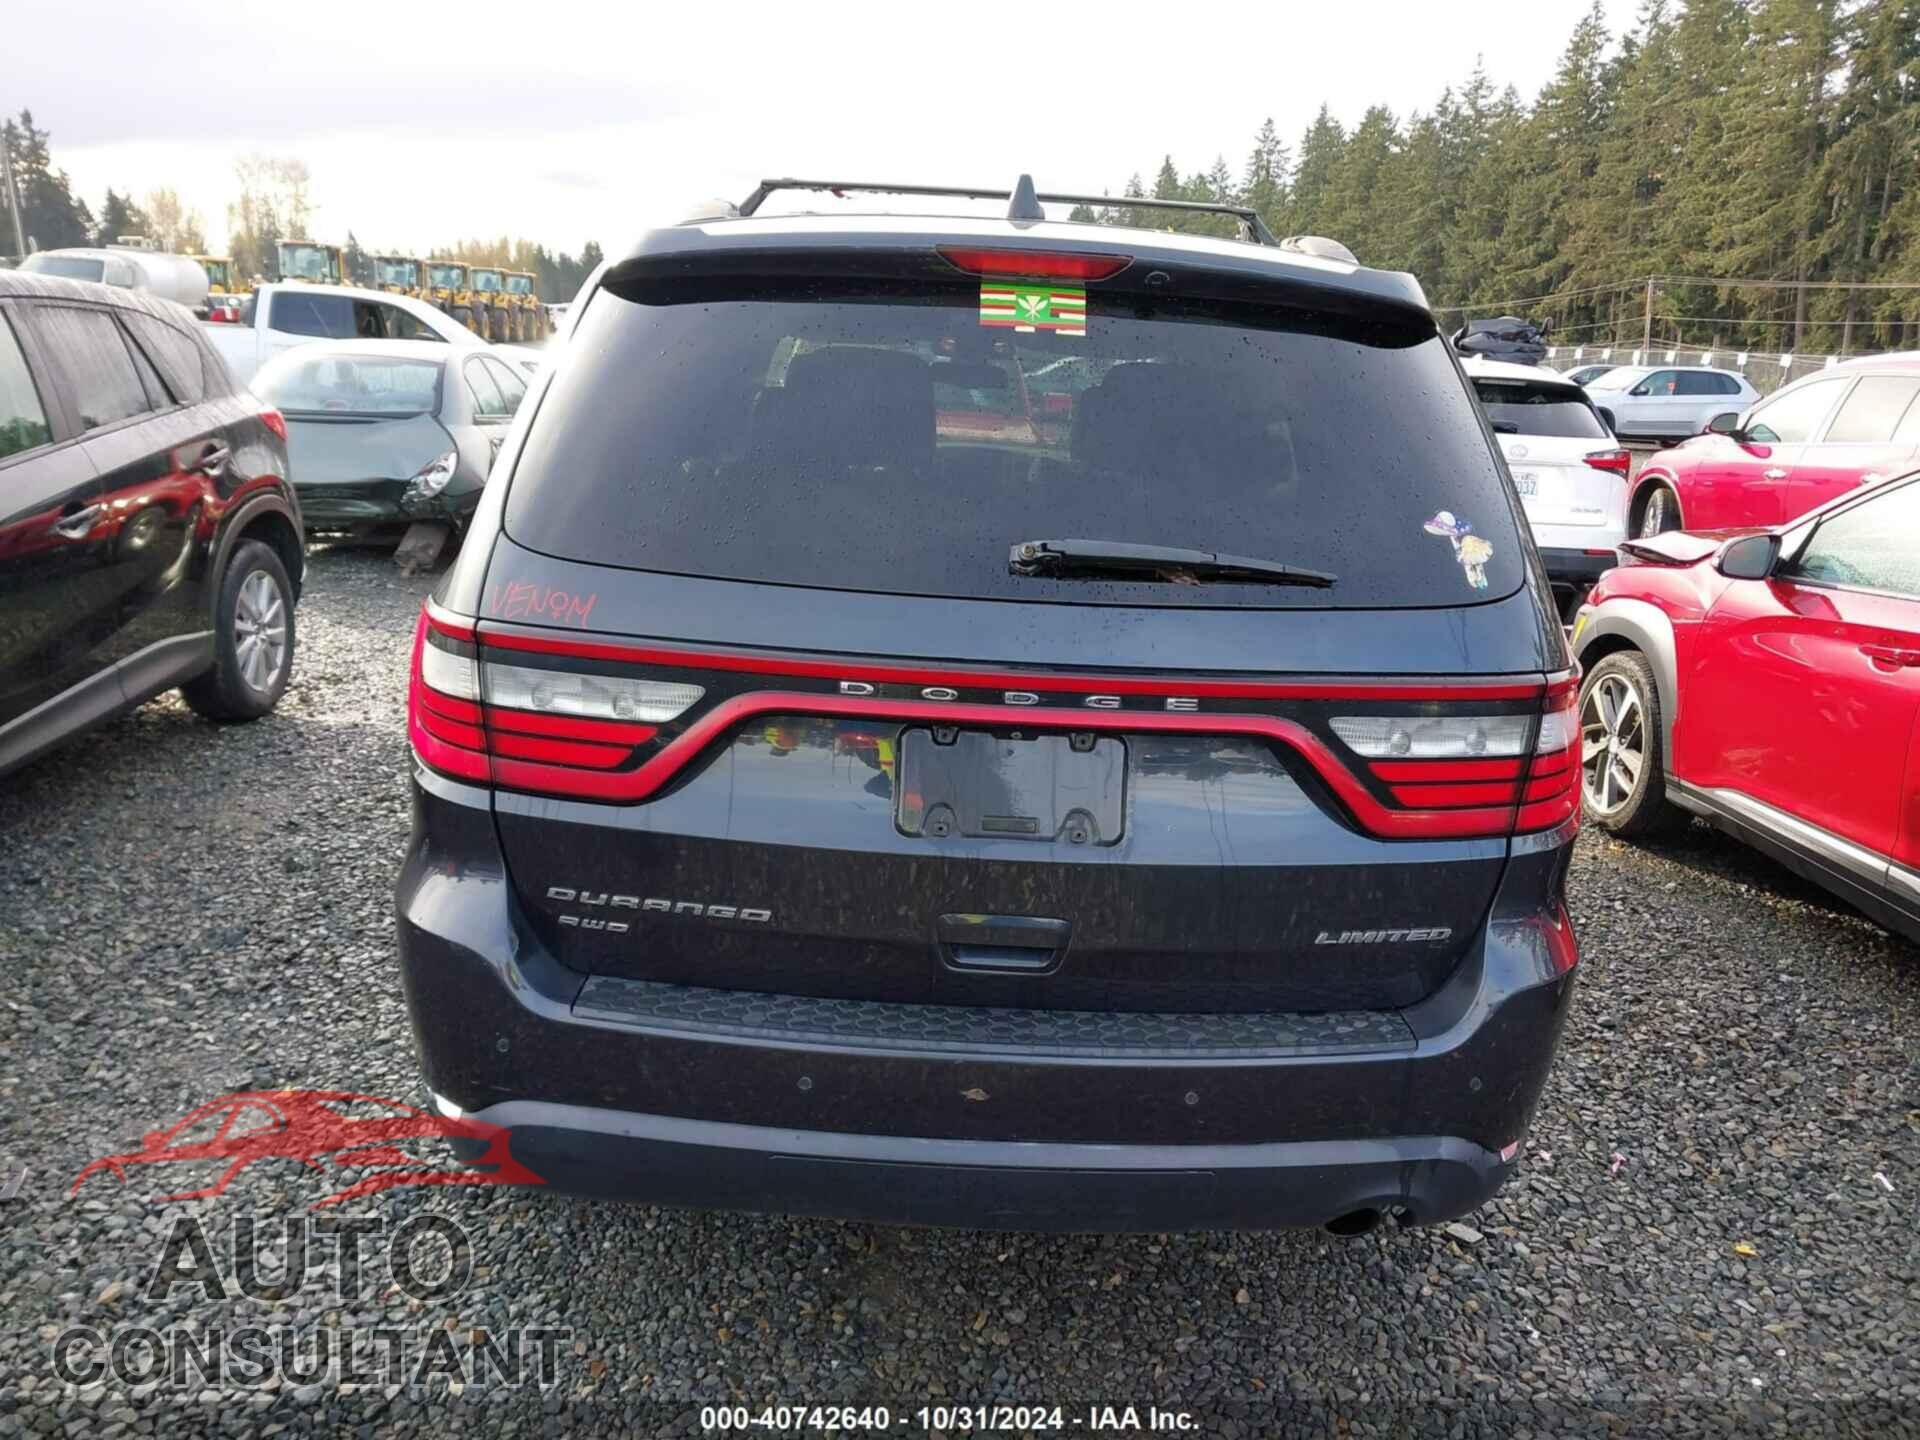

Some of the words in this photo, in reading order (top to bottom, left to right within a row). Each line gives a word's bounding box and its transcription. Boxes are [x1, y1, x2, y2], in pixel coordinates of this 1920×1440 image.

[488, 581, 599, 629] VENOM
[839, 680, 1200, 712] DODGE
[546, 887, 772, 922] DURANGO
[557, 915, 630, 933] AWD
[1314, 927, 1452, 945] LIMITED
